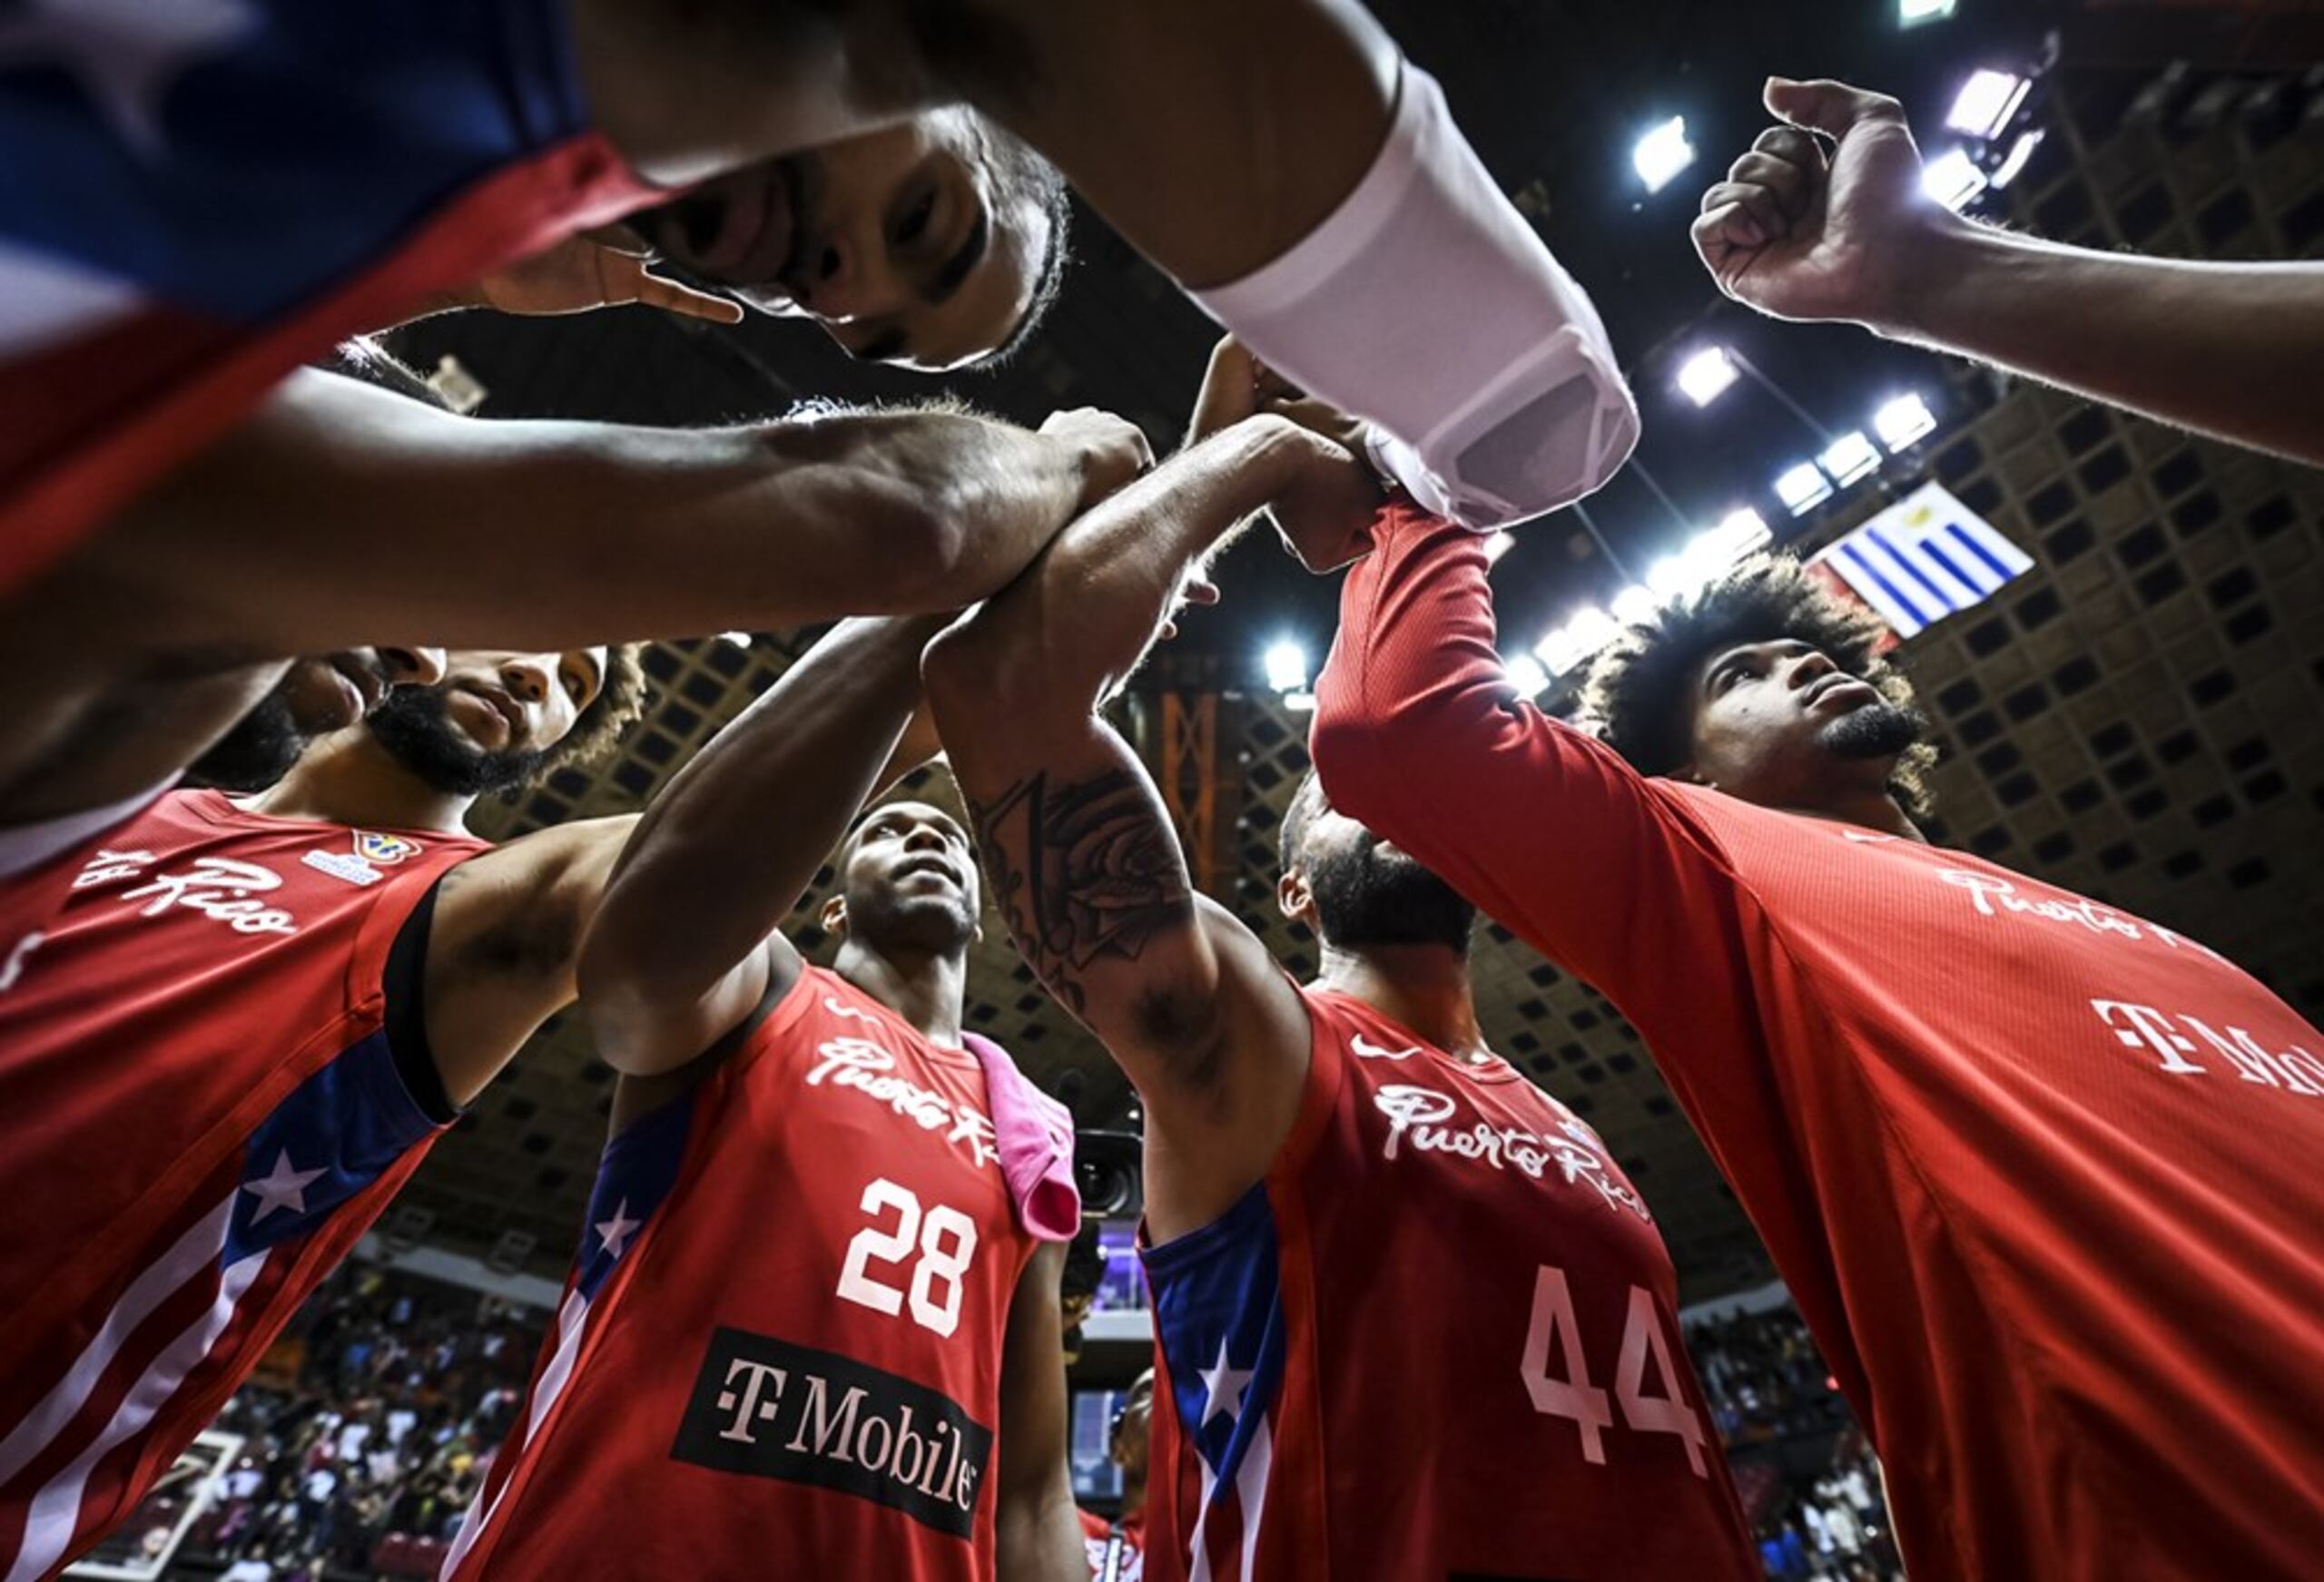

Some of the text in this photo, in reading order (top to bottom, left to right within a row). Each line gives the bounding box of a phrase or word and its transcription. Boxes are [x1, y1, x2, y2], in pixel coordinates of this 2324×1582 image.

[1934, 867, 2142, 939] Puerto
[806, 1037, 950, 1129] Puerto
[1374, 1085, 1551, 1178] Puerto
[835, 1178, 978, 1339] 28
[1520, 1265, 1709, 1480] 44
[716, 1358, 977, 1512] T Mobile
